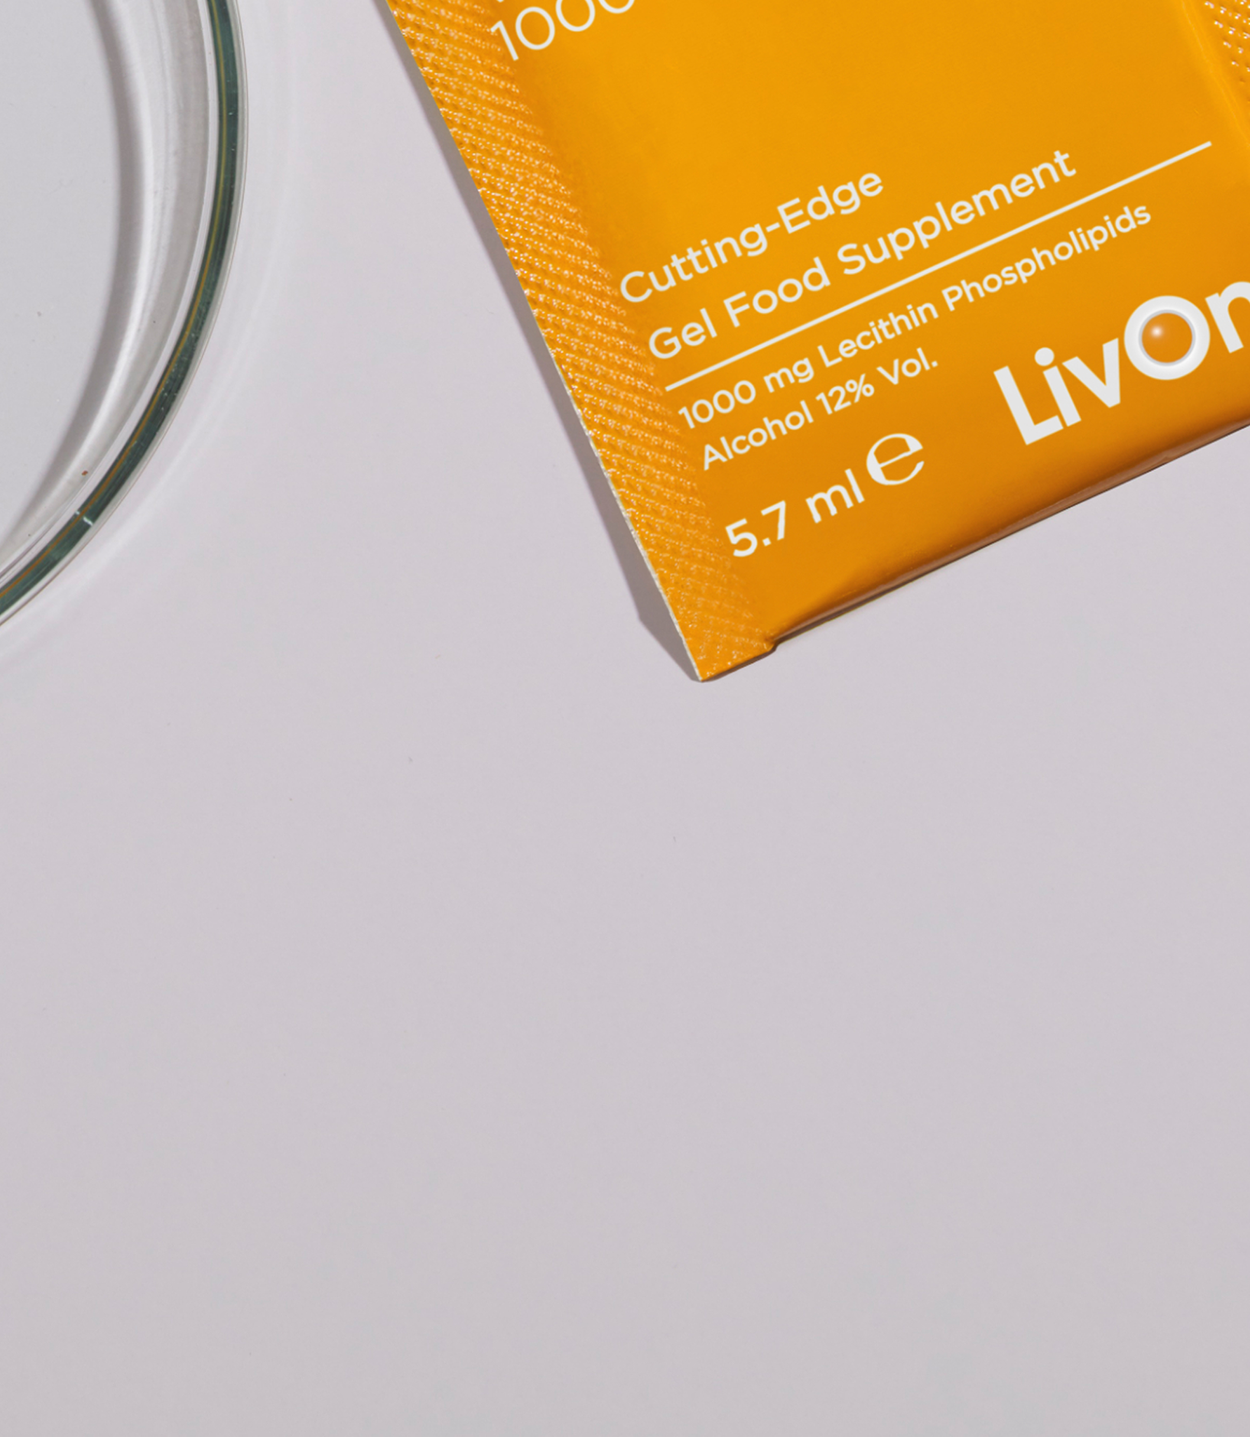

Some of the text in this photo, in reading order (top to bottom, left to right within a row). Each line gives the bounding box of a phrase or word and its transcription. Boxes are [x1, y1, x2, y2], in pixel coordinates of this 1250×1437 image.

[619, 171, 884, 304] Cutting-Edge
[648, 149, 1077, 360] Gel Food Supplement
[677, 201, 1151, 430] 1000 mg Lecithin Phospholipids
[703, 347, 939, 471] Alcohol 12% Vol.
[725, 500, 788, 557] 5.7
[805, 468, 865, 524] ml
